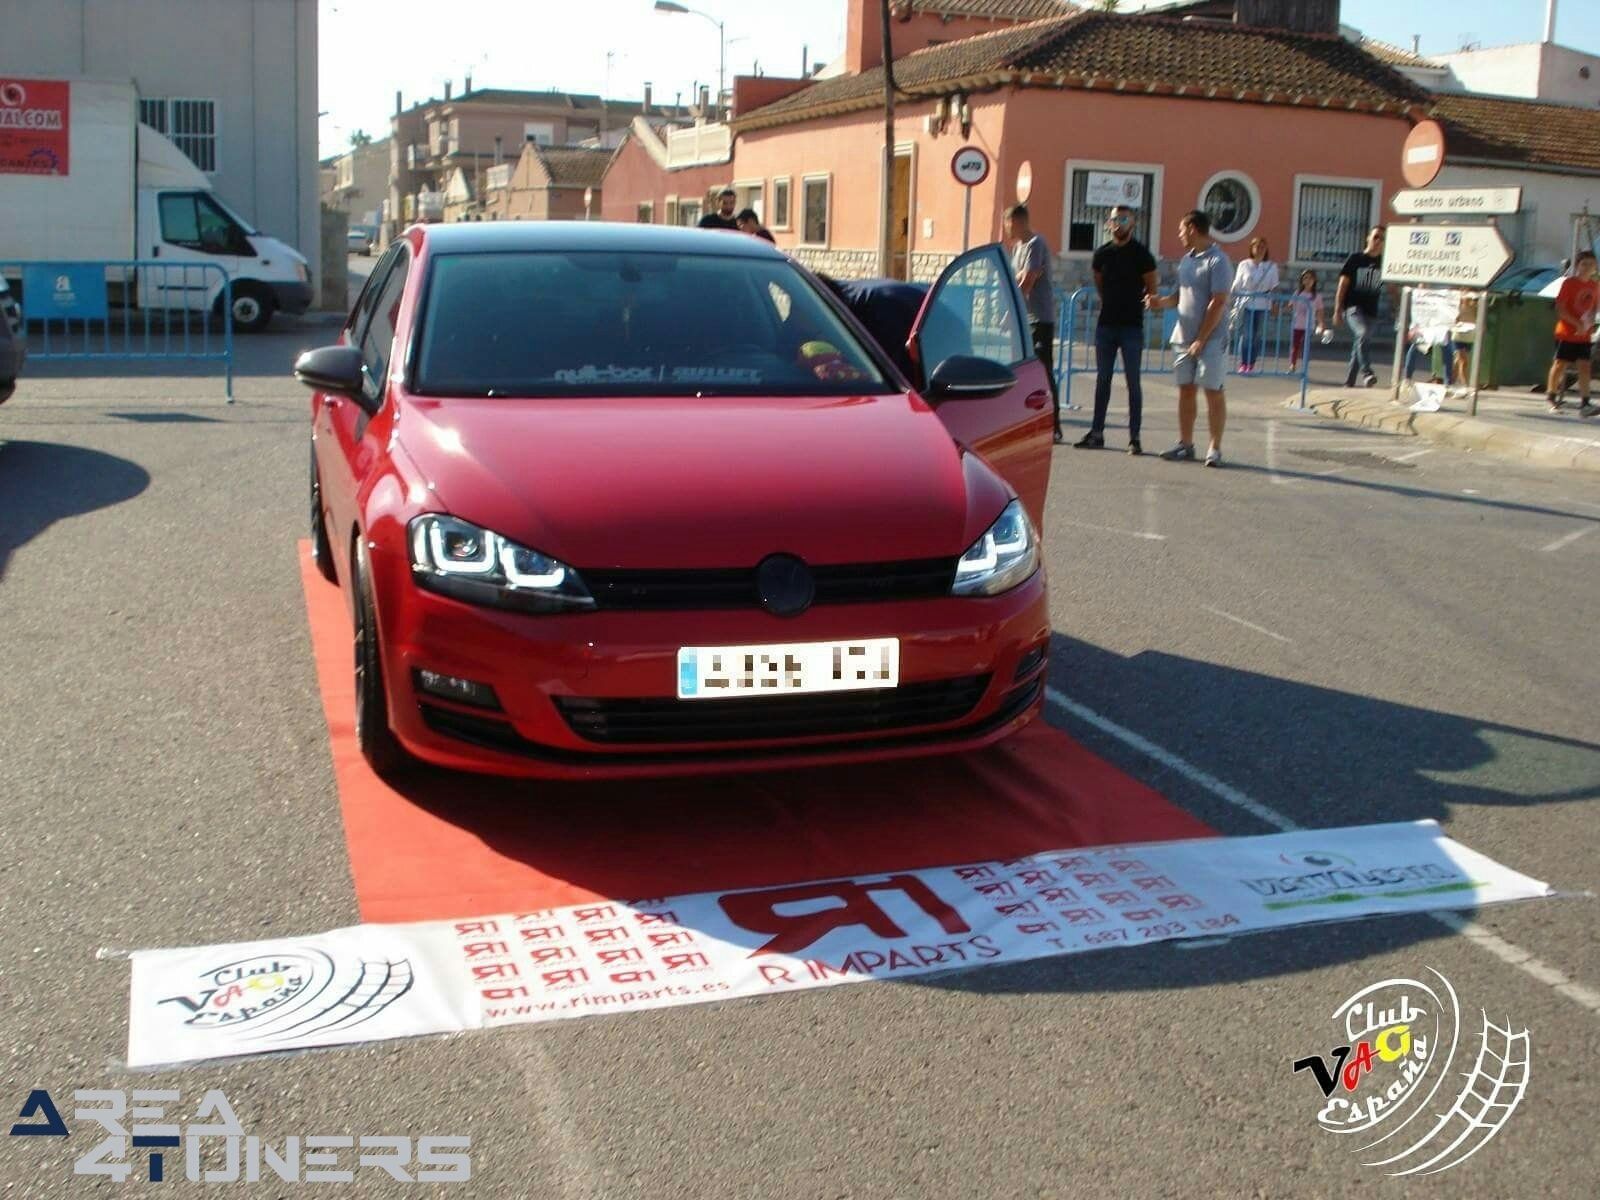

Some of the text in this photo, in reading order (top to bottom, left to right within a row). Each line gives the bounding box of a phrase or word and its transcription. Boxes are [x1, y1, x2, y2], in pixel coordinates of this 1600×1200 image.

[0, 108, 61, 129] ALCOM
[1413, 195, 1484, 207] centro urbano
[758, 935, 1001, 985] RIMPARTS
[213, 961, 293, 987] Club
[485, 980, 731, 1018] www.rimparts.es
